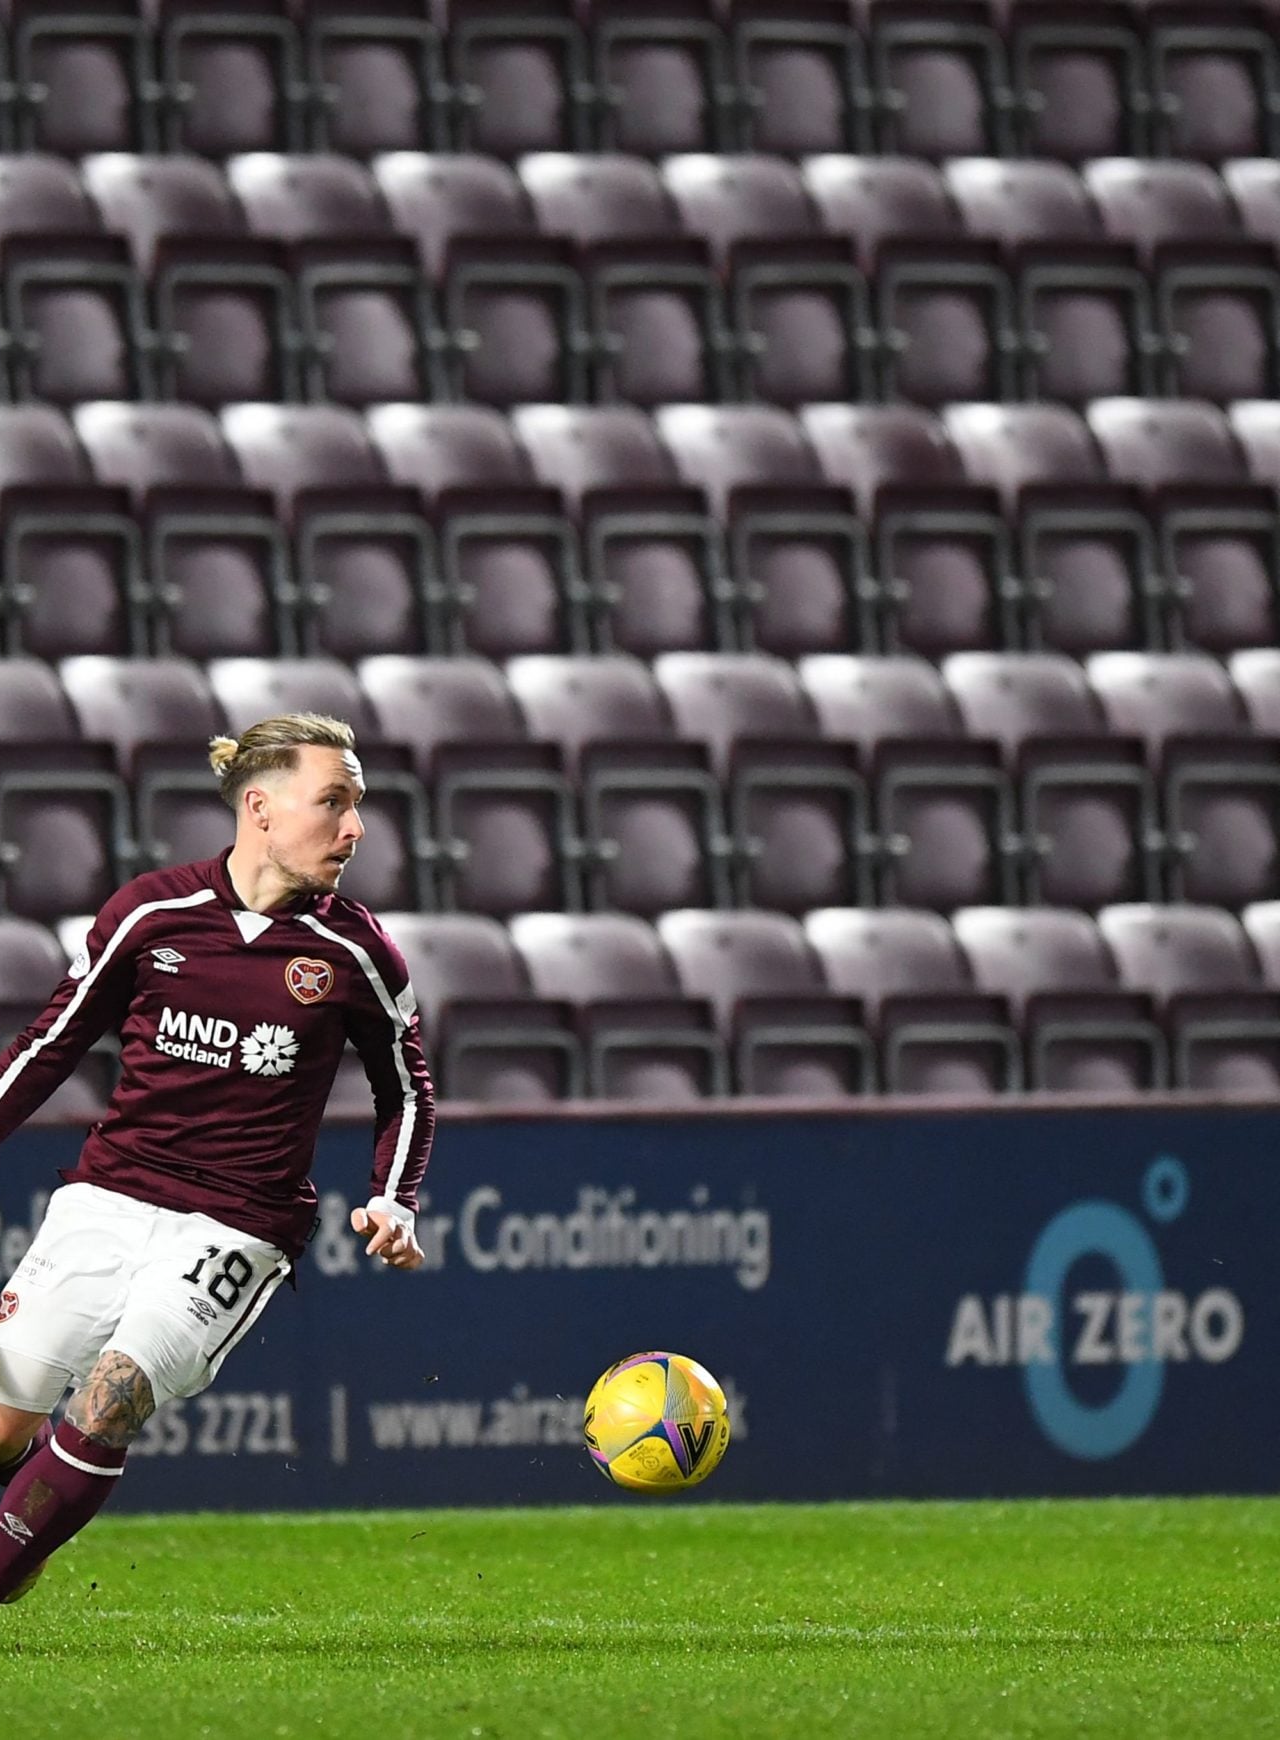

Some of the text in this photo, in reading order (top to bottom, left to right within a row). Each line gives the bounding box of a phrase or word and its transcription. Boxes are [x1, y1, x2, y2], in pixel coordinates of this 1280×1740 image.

[155, 1034, 232, 1069] Scotland
[158, 1006, 239, 1049] MND
[461, 1185, 770, 1289] Conditioning
[182, 1246, 253, 1310] 18
[946, 1288, 1244, 1366] AIR ZERO
[198, 1393, 295, 1454] 2721
